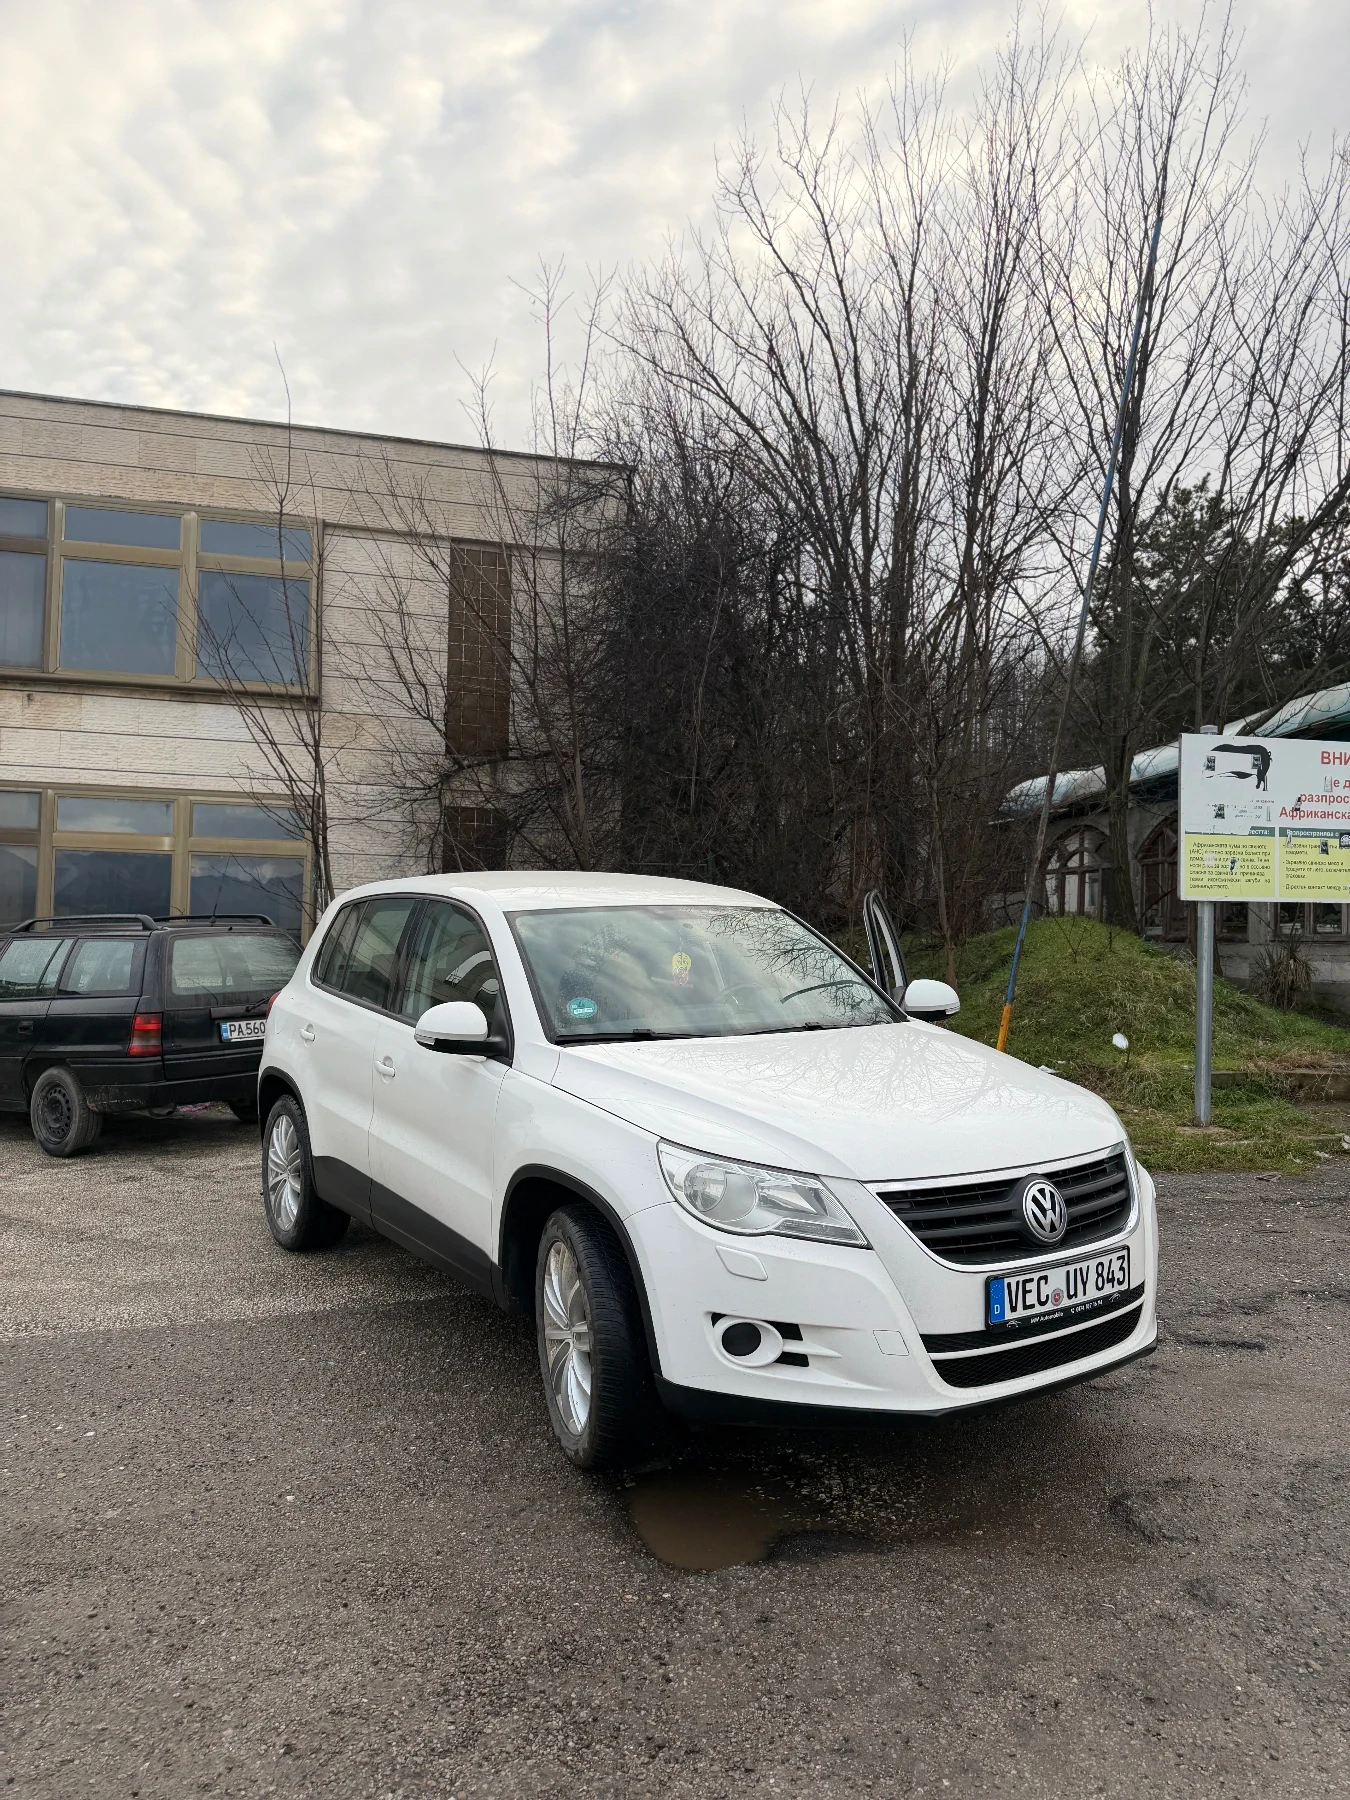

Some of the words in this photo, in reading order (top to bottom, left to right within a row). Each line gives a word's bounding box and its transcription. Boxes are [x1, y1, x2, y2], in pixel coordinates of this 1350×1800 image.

[1300, 793, 1350, 806] разпрос
[994, 1304, 1001, 1315] D
[1006, 1274, 1050, 1313] VEC
[1065, 1265, 1090, 1300] UY
[1094, 1254, 1126, 1292] 843
